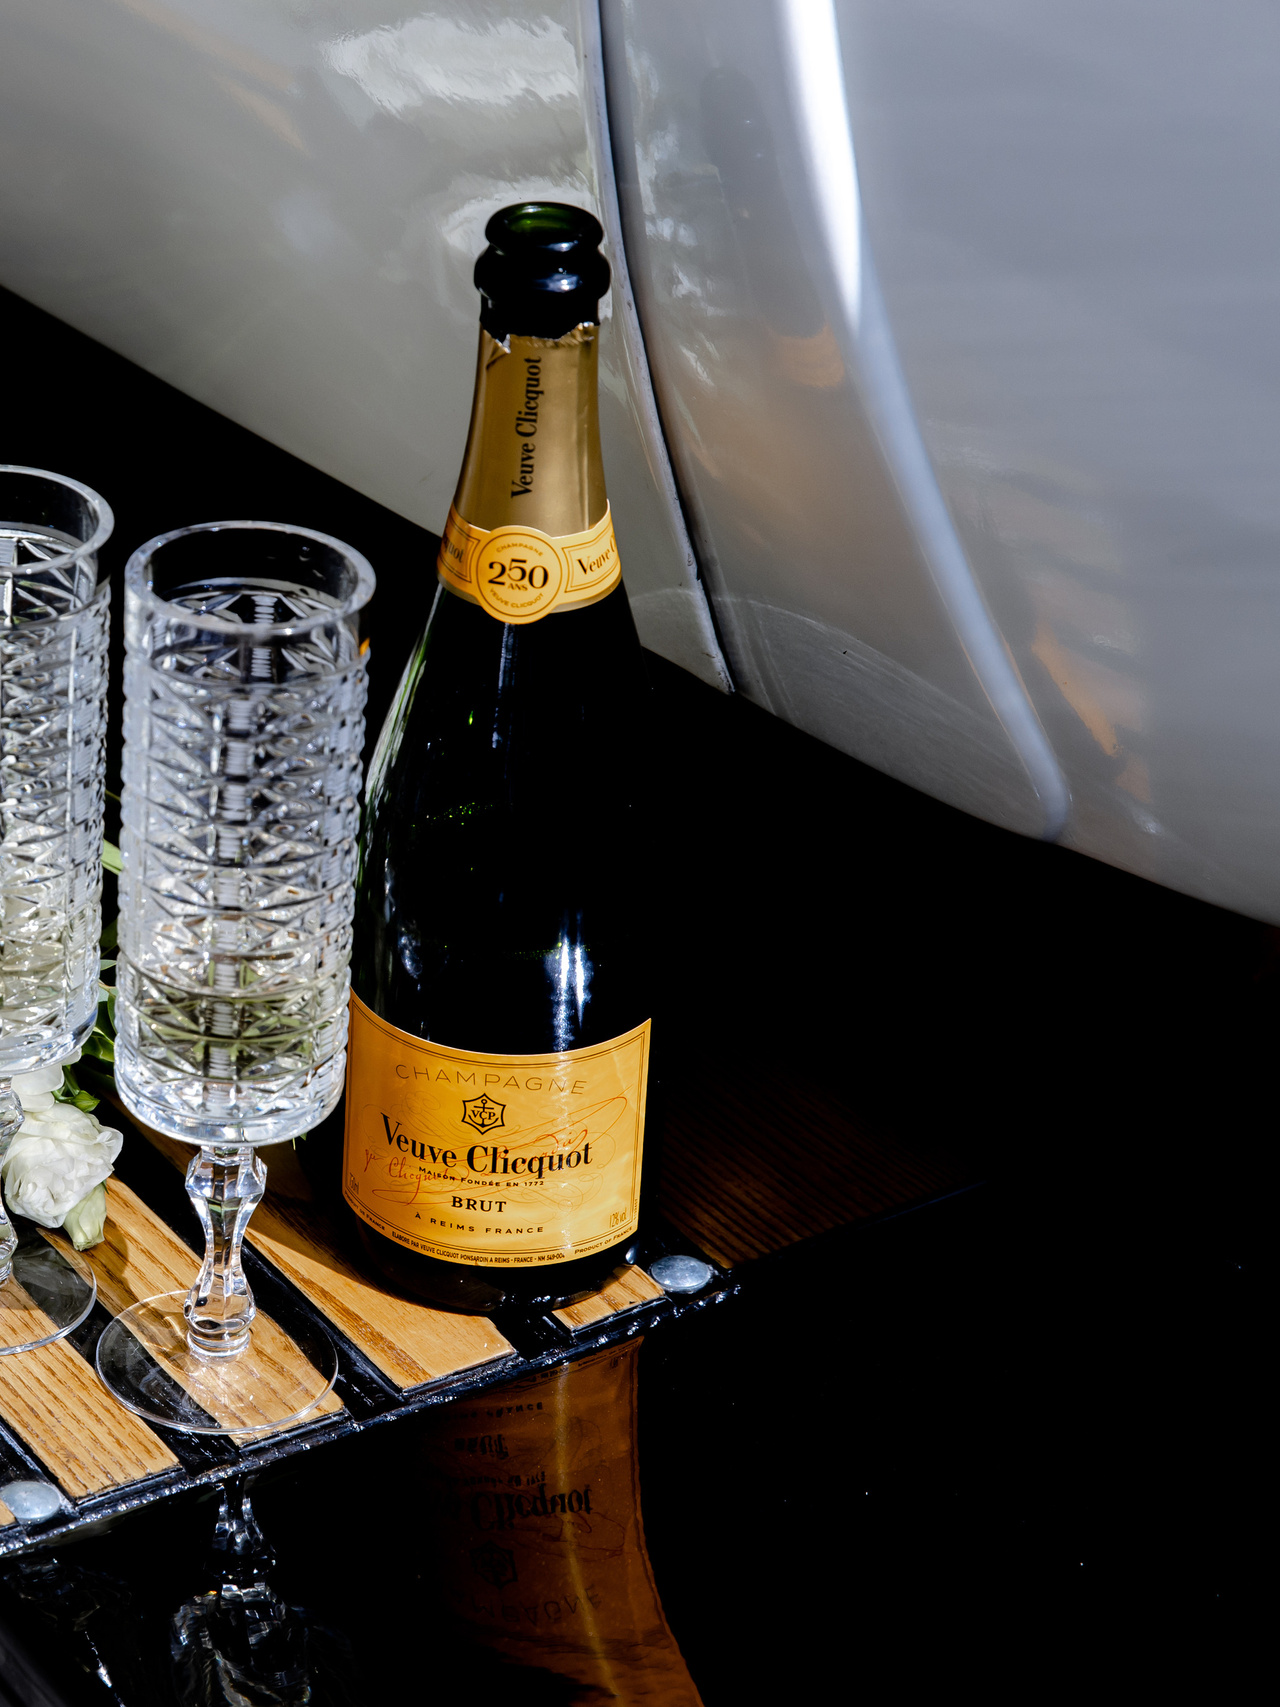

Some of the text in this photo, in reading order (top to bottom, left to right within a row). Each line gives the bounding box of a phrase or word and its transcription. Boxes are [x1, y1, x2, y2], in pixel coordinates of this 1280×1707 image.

[511, 356, 544, 498] Veuve Clicquot
[496, 543, 543, 556] CHAMPAGNE
[488, 558, 549, 589] 250
[508, 583, 528, 591] ANS
[490, 588, 543, 608] VEUVE CLICQUOT
[395, 1064, 587, 1095] CHAMPAGNE
[381, 1112, 457, 1168] Veuve
[467, 1143, 593, 1179] Clicquot
[418, 1166, 456, 1181] MAISON
[461, 1178, 500, 1187] FONDÉE
[451, 1196, 507, 1212] BRUT
[430, 1218, 475, 1232] REIMS
[574, 1243, 603, 1254] PRODUCT
[613, 1226, 633, 1240] FRANCE
[411, 1241, 420, 1249] PAR
[420, 1244, 436, 1253] VEUVE
[436, 1248, 460, 1259] CLICQUOT
[460, 1253, 489, 1263] PONSARDIN
